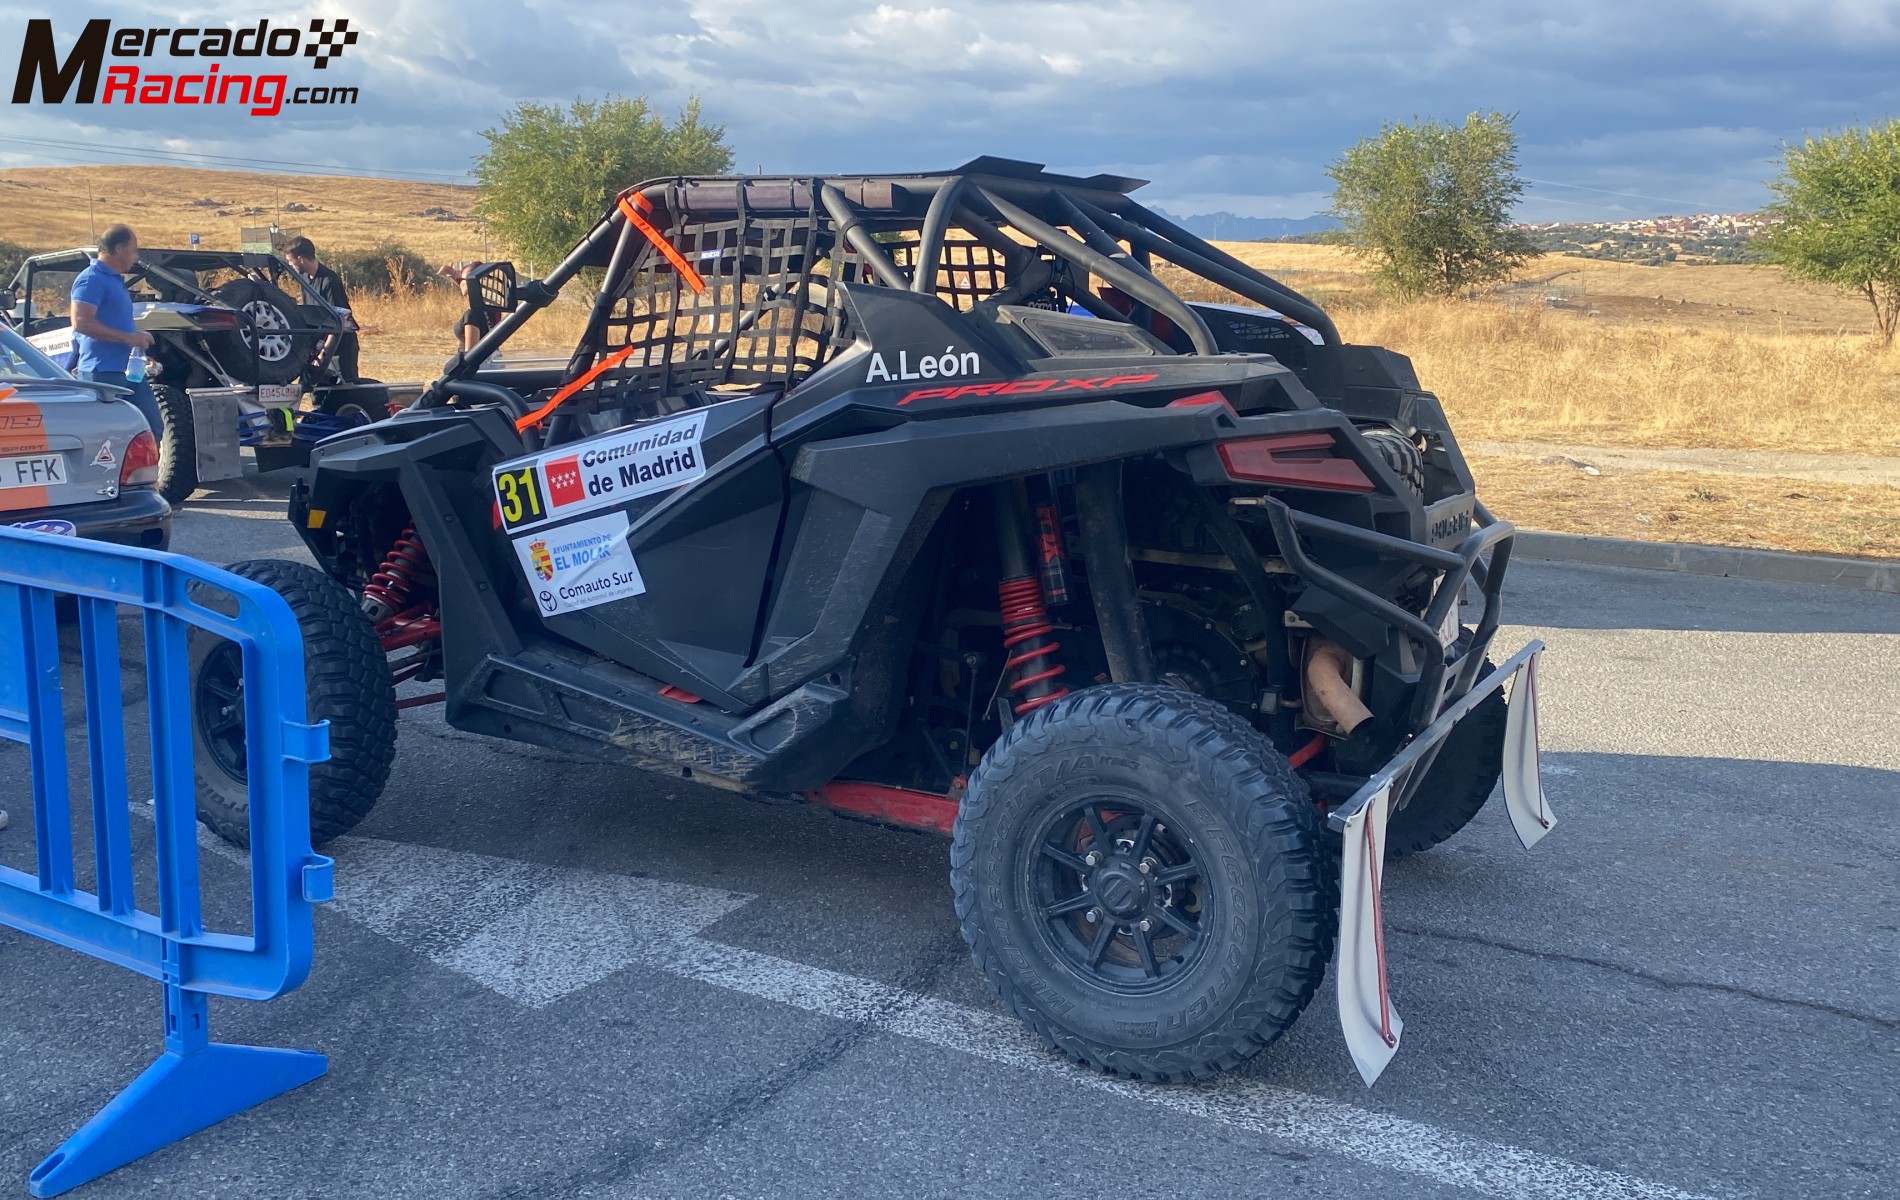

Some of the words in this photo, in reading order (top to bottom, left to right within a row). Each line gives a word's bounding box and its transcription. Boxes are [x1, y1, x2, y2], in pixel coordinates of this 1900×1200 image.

[865, 346, 980, 383] A.León
[0, 445, 44, 453] SPORT
[582, 424, 698, 468] Comunidad
[15, 458, 60, 484] FFK
[588, 475, 614, 497] de
[619, 446, 697, 488] Madrid
[499, 466, 540, 523] 31
[553, 535, 602, 555] AYUNTAMIENTO
[603, 533, 612, 542] DE
[555, 556, 571, 571] EL
[572, 544, 612, 567] MOLAR
[559, 578, 611, 600] Comauto
[612, 571, 634, 586] Sur
